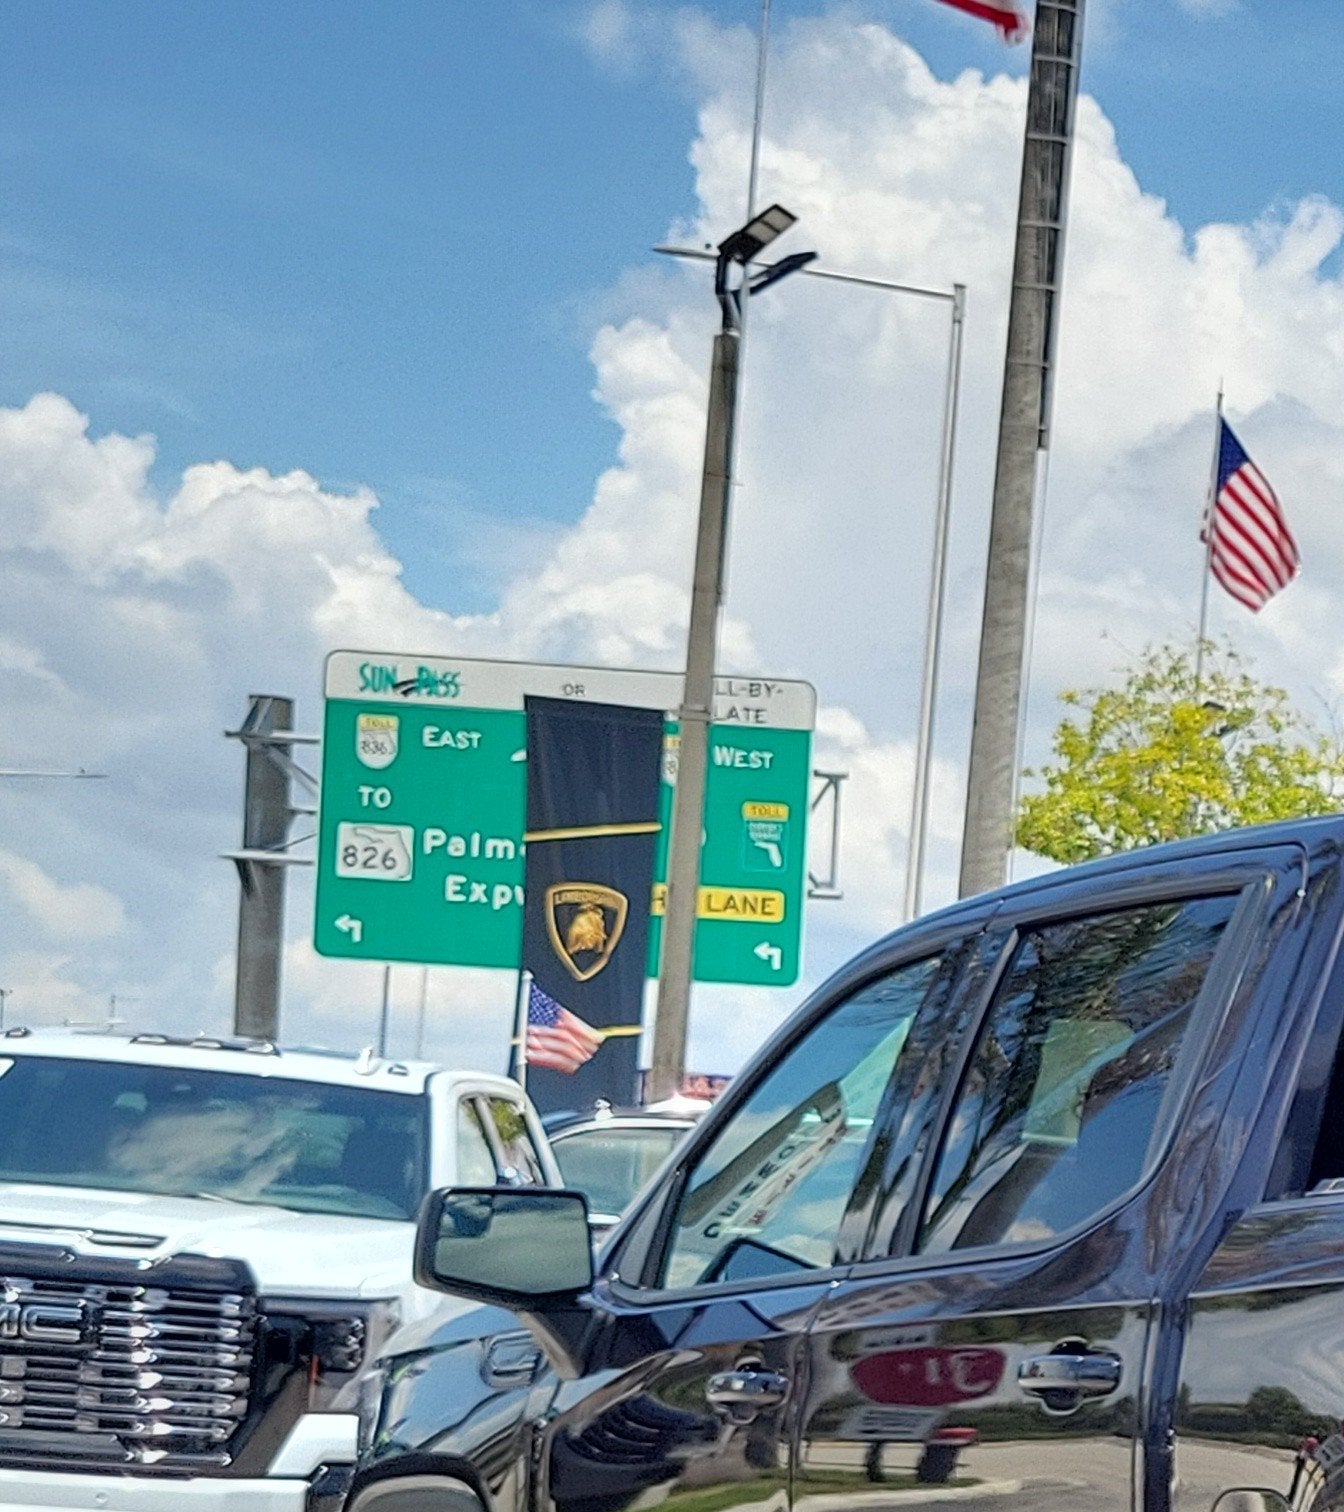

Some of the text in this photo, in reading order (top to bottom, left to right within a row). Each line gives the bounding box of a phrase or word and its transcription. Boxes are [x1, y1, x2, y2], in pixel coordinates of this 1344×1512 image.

[561, 683, 586, 697] OR
[422, 725, 482, 749] EAST
[713, 745, 774, 769] WEST
[358, 785, 392, 809] TO
[423, 827, 526, 860] Palm
[342, 844, 398, 870] 826
[706, 893, 777, 916] LANE
